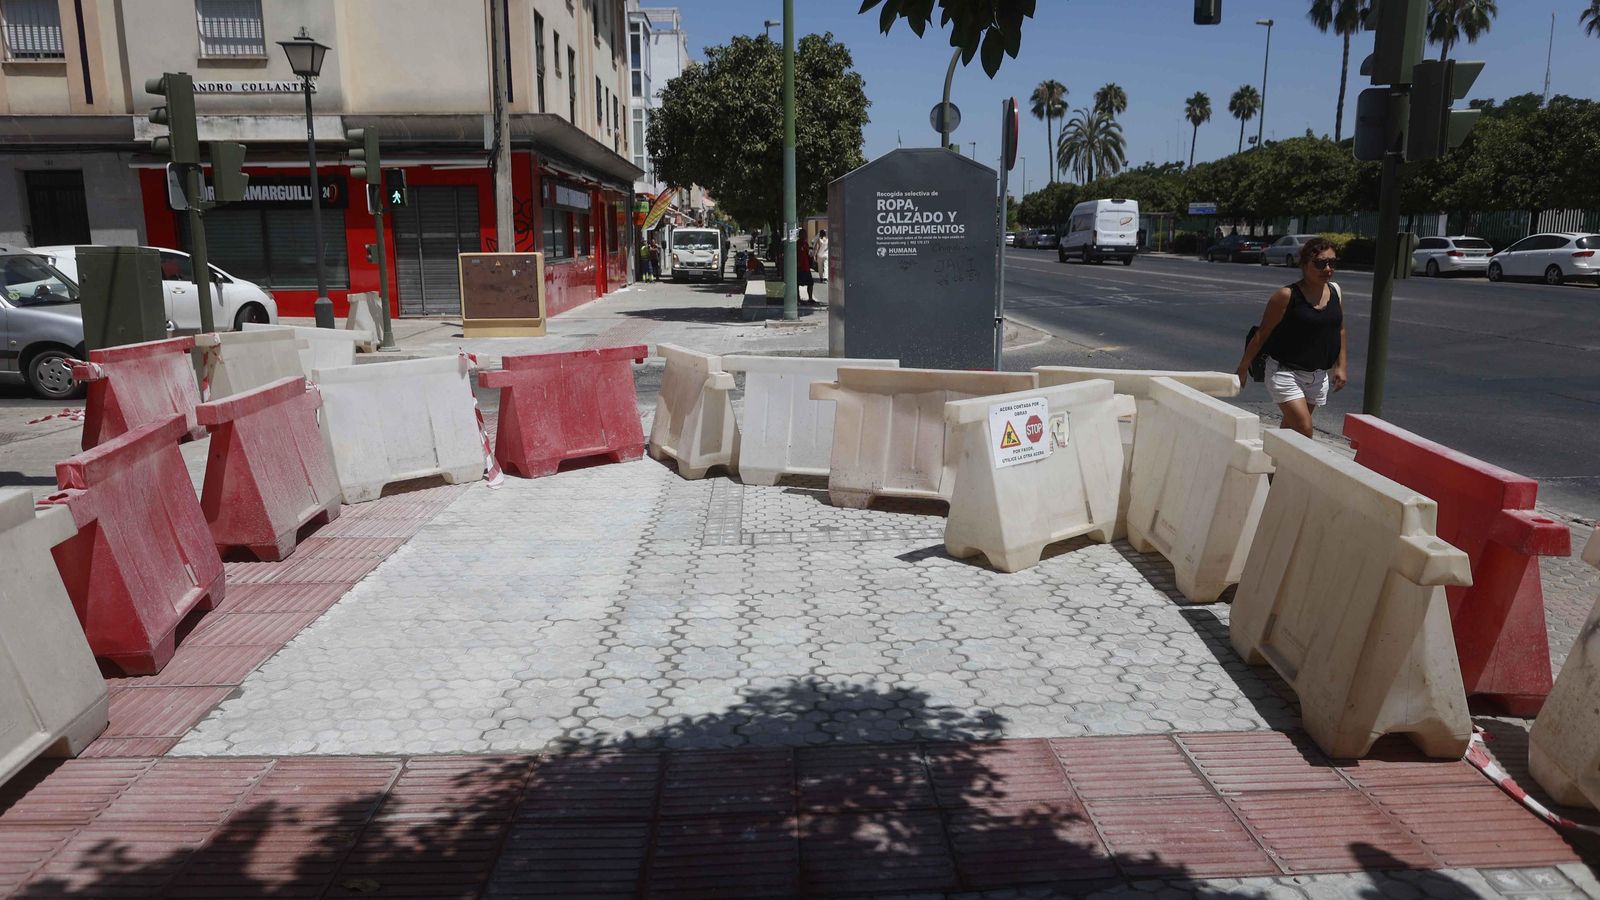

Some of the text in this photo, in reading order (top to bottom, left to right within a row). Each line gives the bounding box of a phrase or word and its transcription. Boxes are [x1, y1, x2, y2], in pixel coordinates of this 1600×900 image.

[193, 83, 233, 92] ANDRO
[243, 185, 312, 201] AMARGUILL
[876, 199, 919, 212] ROPA,
[876, 211, 958, 224] CALZADO Y
[876, 224, 965, 235] COMPLEMENTOS
[1026, 423, 1043, 436] STOP
